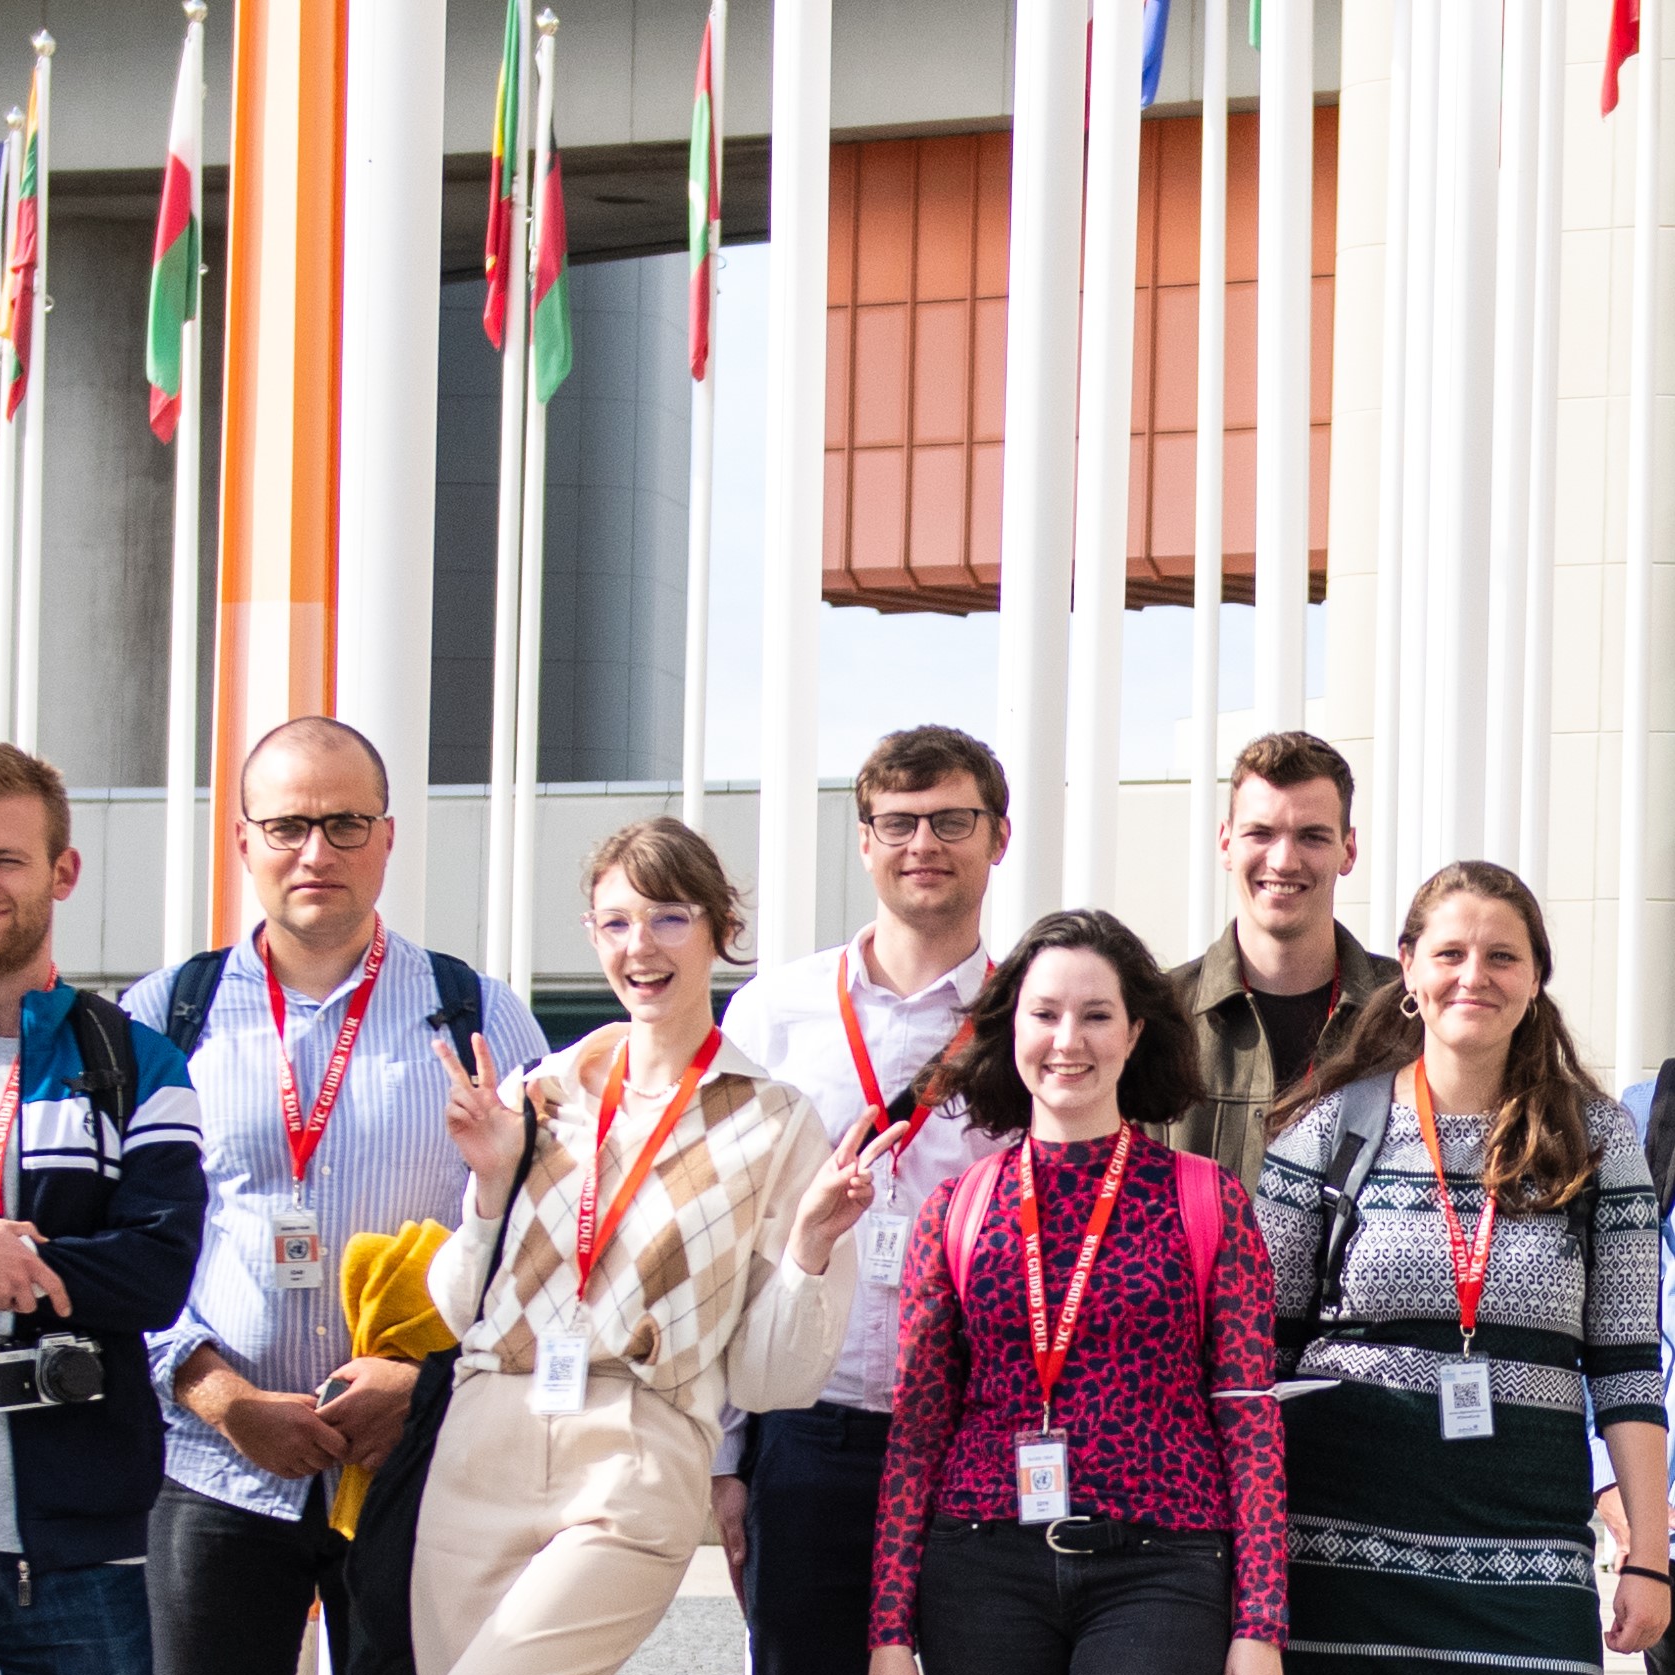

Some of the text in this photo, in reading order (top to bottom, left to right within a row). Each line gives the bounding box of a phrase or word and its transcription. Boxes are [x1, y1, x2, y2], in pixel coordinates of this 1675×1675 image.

[364, 956, 381, 980] VIC
[309, 1016, 360, 1132] VIC GUIDED TOUR
[283, 1090, 302, 1133] TOUR
[1100, 1125, 1131, 1199] VIC GUIDED
[578, 1212, 595, 1255] TOUR
[1025, 1233, 1049, 1353] VIC GUIDED TOUR
[1053, 1234, 1099, 1352] VIC GUIDED TOUR
[1468, 1256, 1484, 1284] VIC
